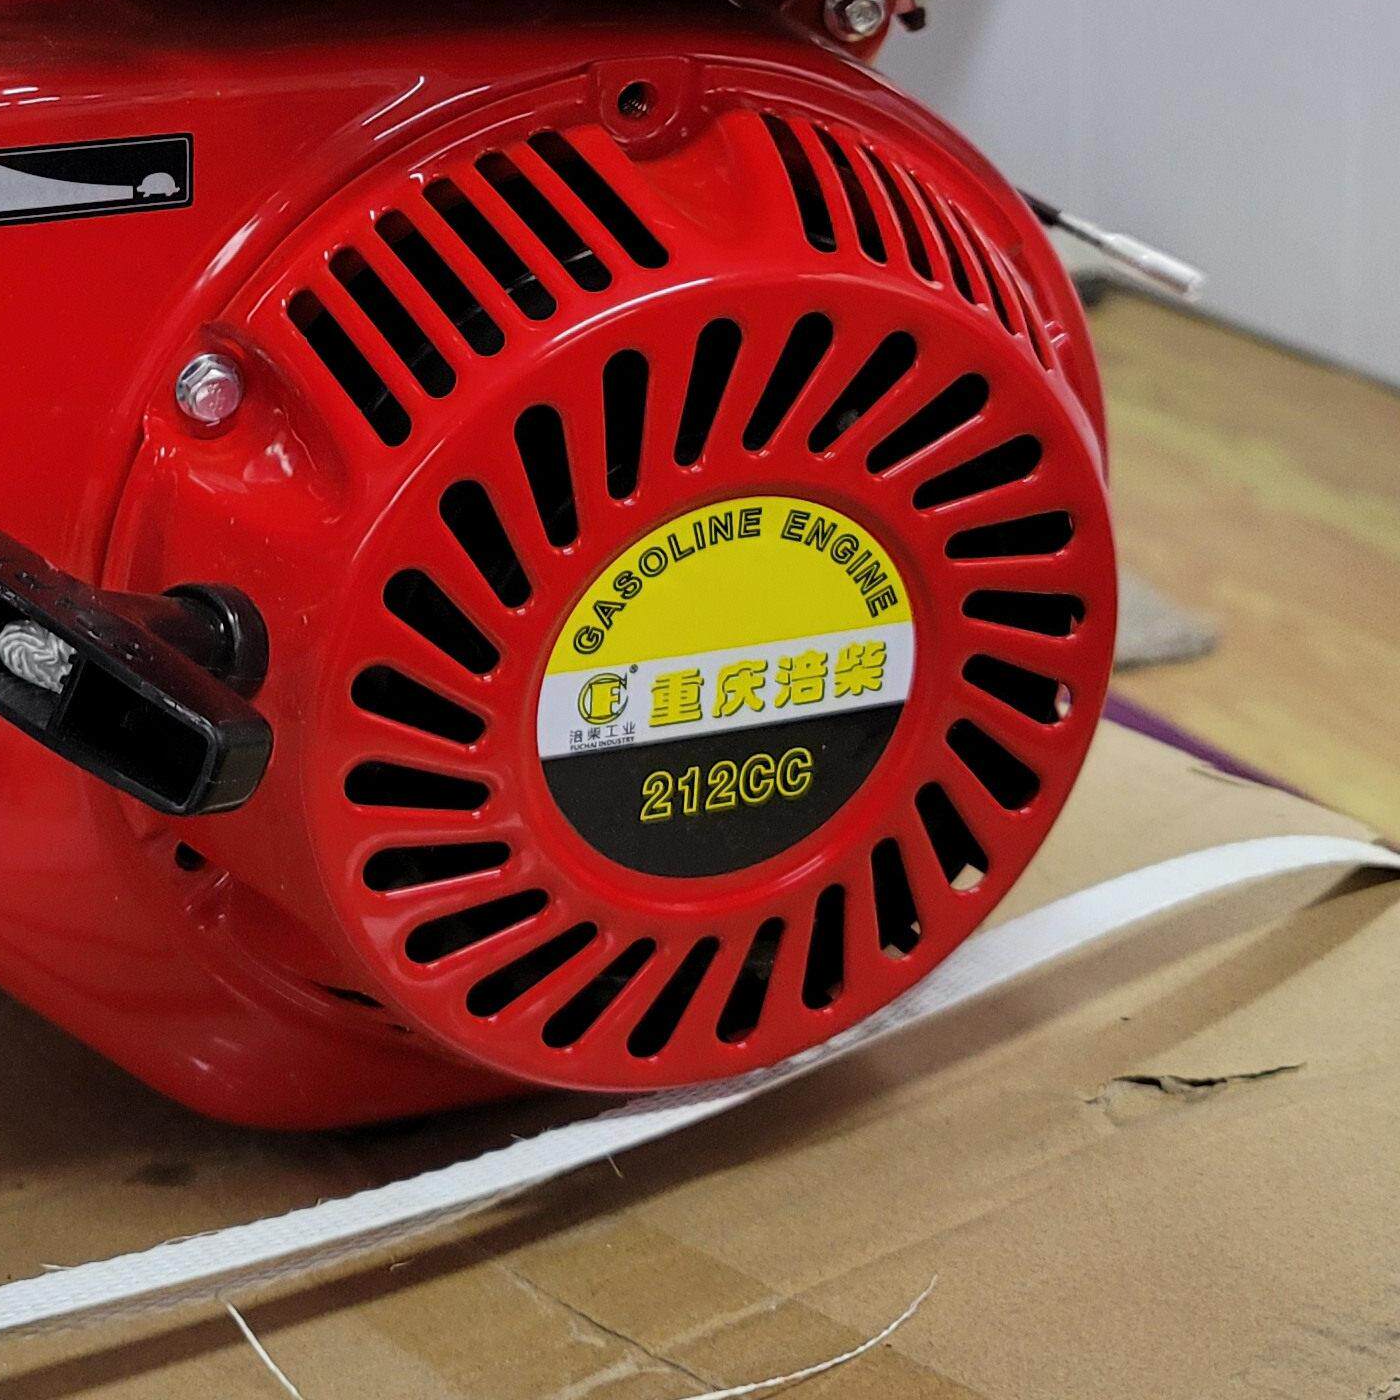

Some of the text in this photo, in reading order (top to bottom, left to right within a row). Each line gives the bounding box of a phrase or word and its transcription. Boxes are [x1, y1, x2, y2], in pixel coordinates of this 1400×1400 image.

[573, 507, 898, 655] GASOLINE ENGINE
[648, 640, 887, 728] 重庆涪柴
[640, 747, 813, 823] 212CC
